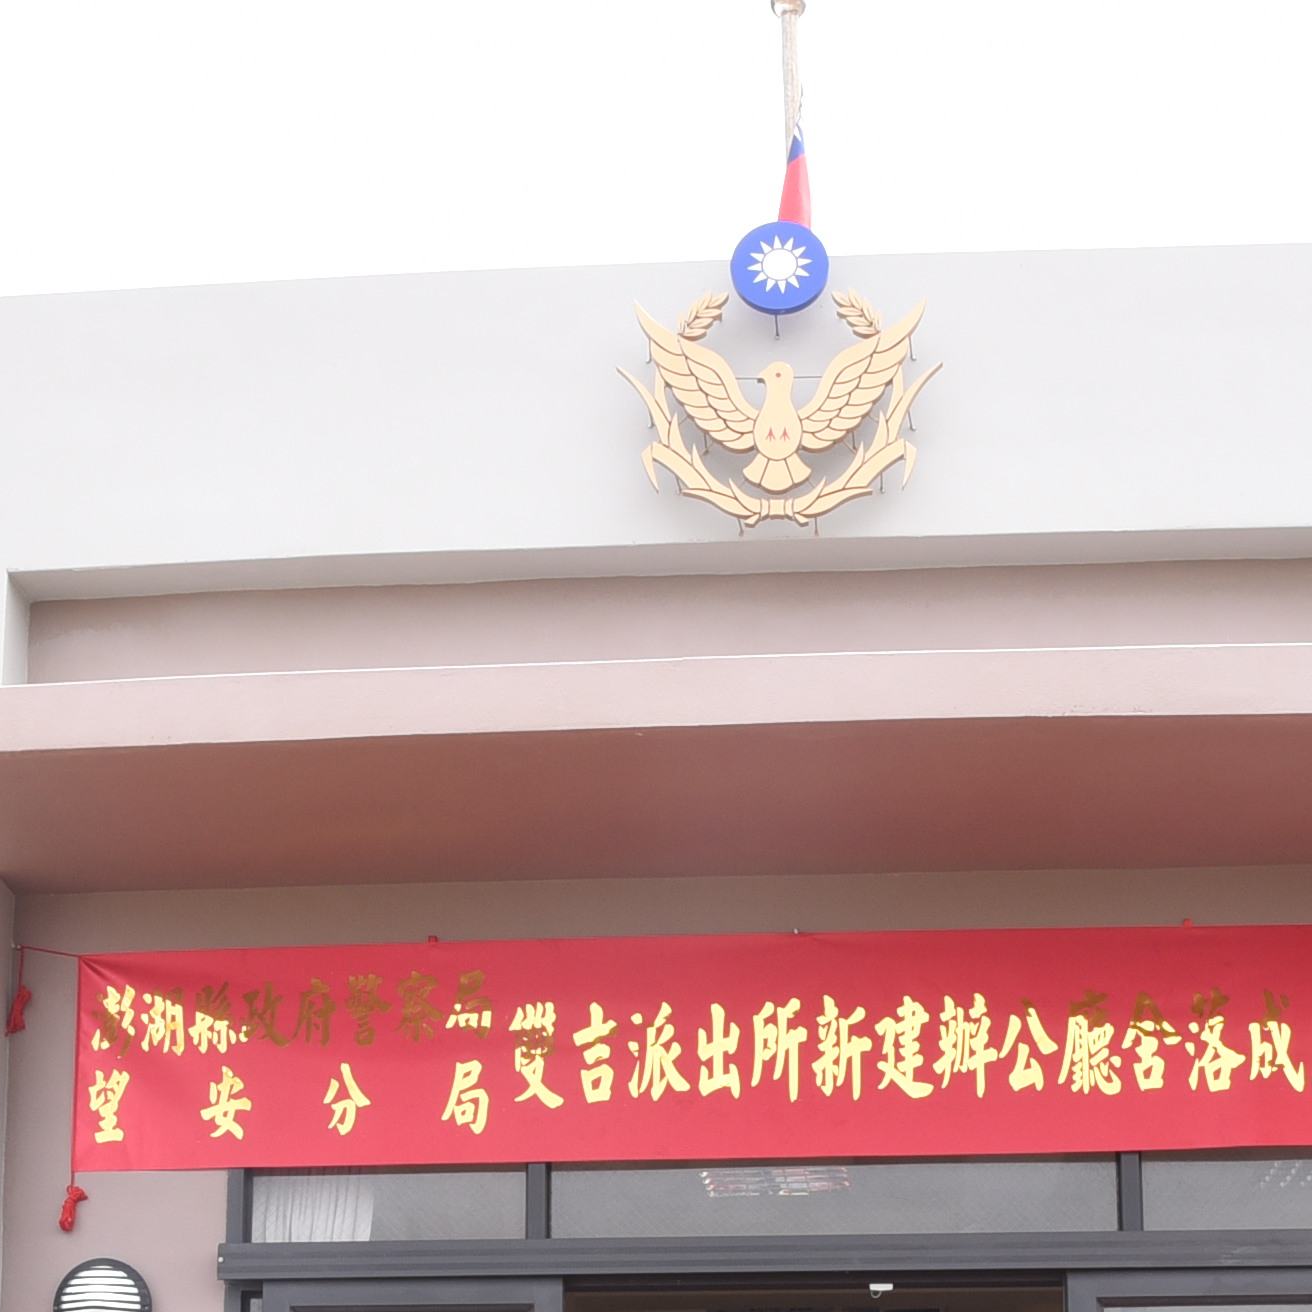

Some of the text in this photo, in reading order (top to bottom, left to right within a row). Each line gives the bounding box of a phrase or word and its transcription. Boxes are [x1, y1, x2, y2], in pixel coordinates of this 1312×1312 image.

[90, 969, 494, 1059] 澎湖縣政府警察局
[88, 1059, 491, 1145] 望安分局
